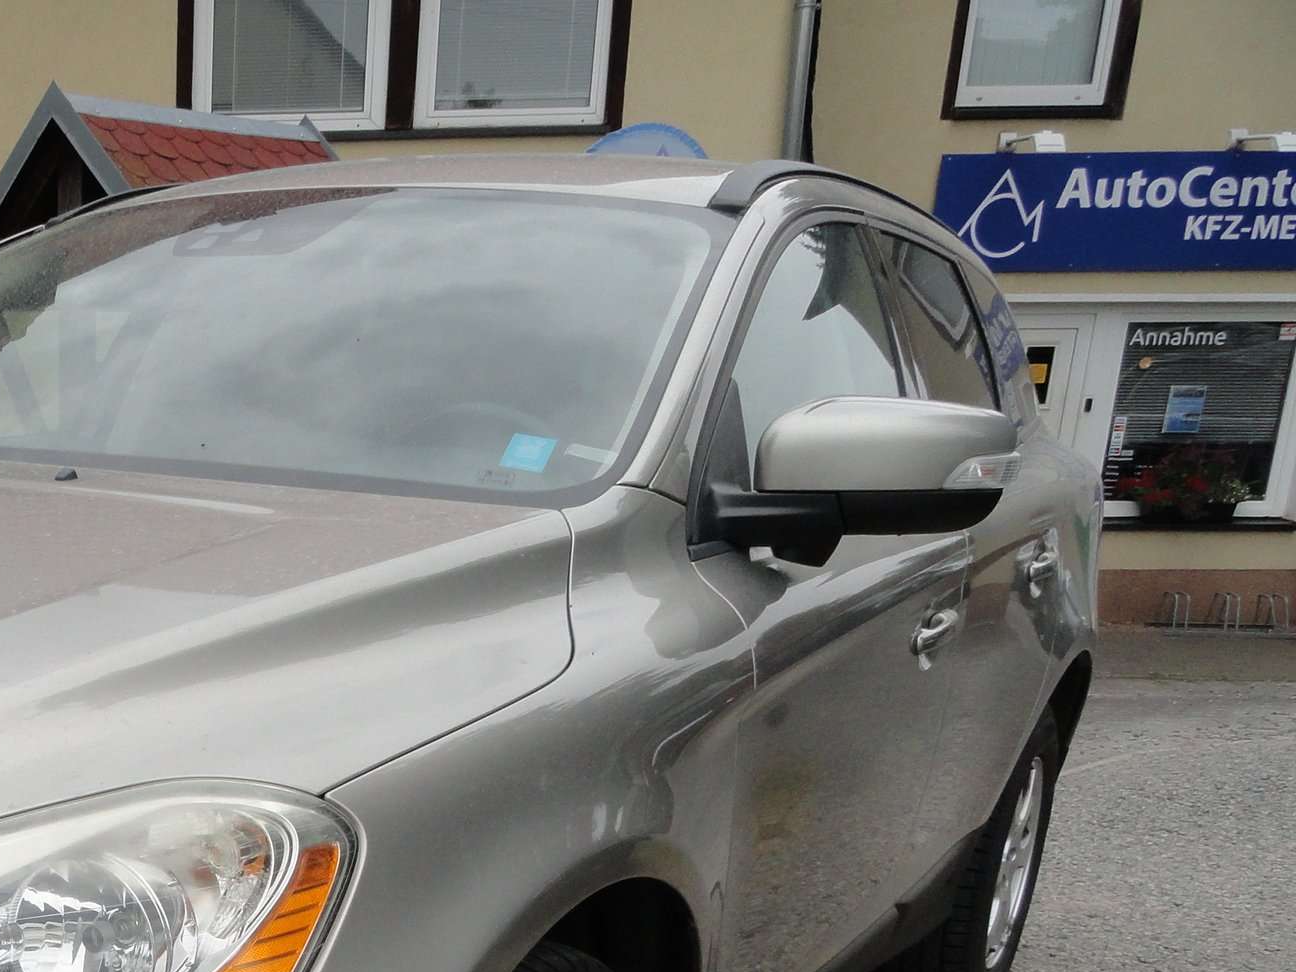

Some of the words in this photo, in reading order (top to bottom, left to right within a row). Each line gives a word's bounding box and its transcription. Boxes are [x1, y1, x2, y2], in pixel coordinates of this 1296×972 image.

[1056, 166, 1296, 208] AutoCent
[1184, 214, 1296, 240] KFZ-ME
[1129, 327, 1227, 347] Annahme
